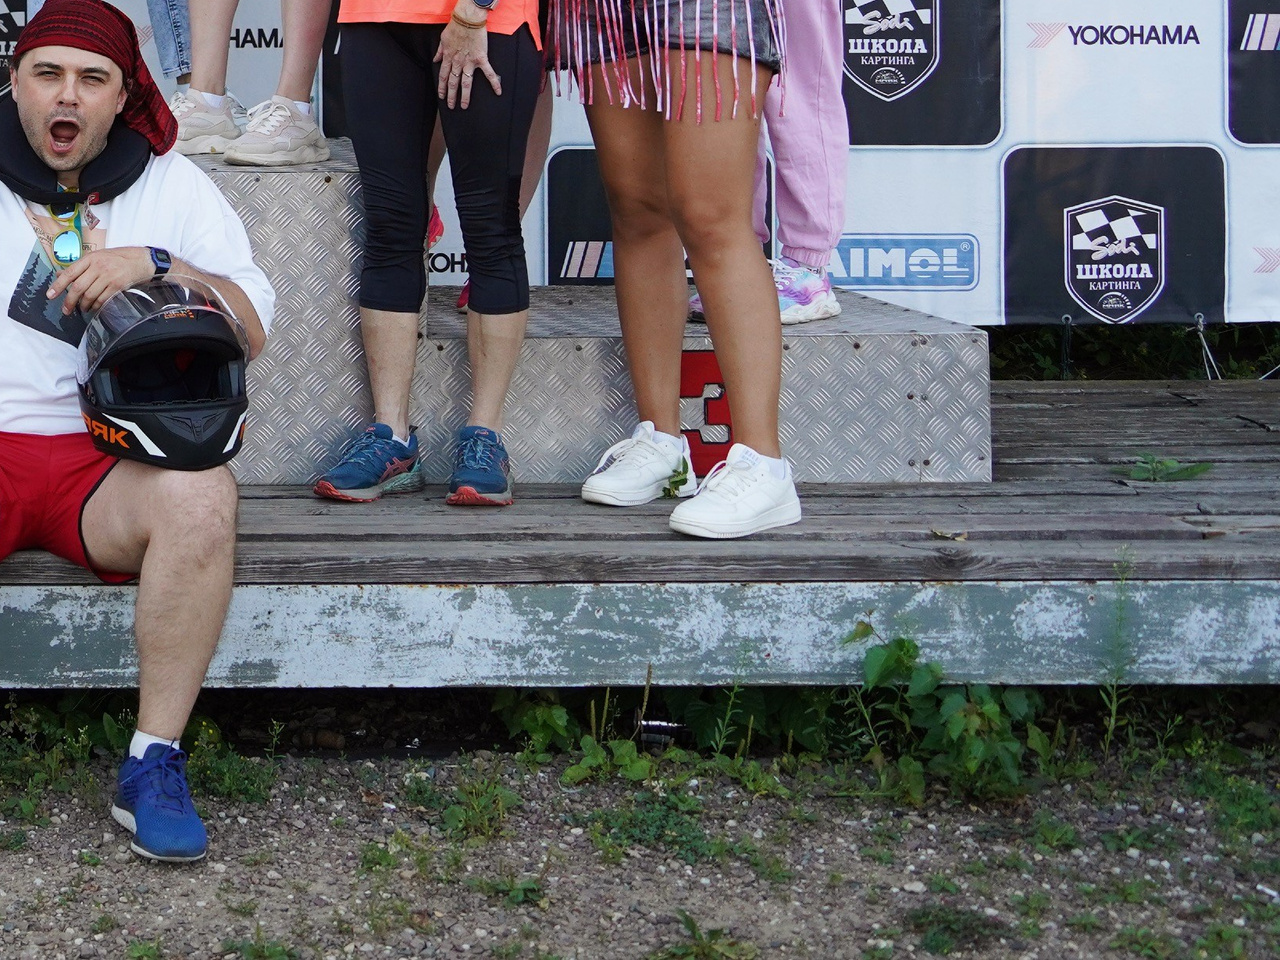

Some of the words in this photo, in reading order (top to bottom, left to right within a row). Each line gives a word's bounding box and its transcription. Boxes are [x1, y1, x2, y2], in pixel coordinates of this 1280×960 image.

[1068, 25, 1200, 45] YOKOHAMA
[848, 38, 927, 54] ШКОЛА
[861, 56, 915, 65] КАРТИНГА
[1076, 263, 1153, 280] ШКОЛА
[1089, 281, 1141, 291] КАРТИНГА
